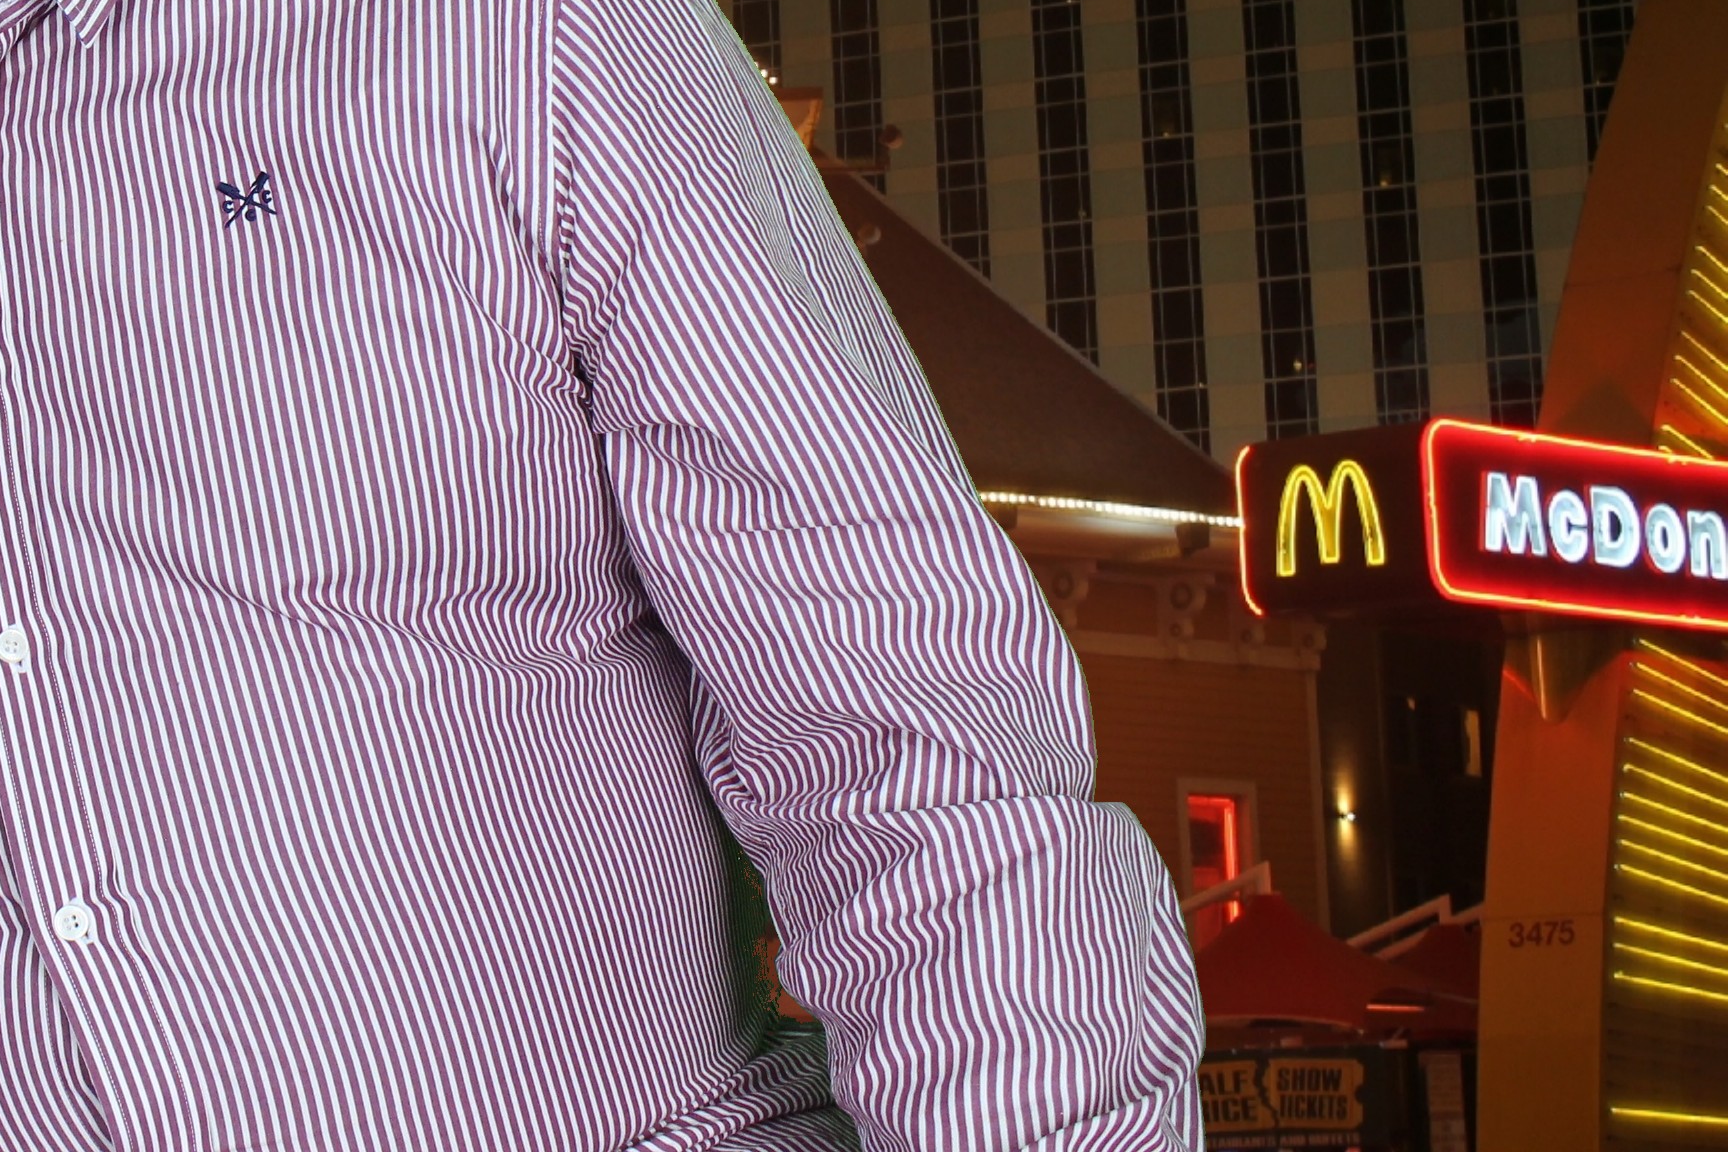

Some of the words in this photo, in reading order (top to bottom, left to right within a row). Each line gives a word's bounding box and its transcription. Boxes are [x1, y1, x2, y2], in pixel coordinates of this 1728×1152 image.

[1485, 471, 1728, 579] McDon
[1508, 920, 1575, 948] 3475
[1277, 1067, 1342, 1092] SHOW
[1279, 1094, 1348, 1120] TICKETS
